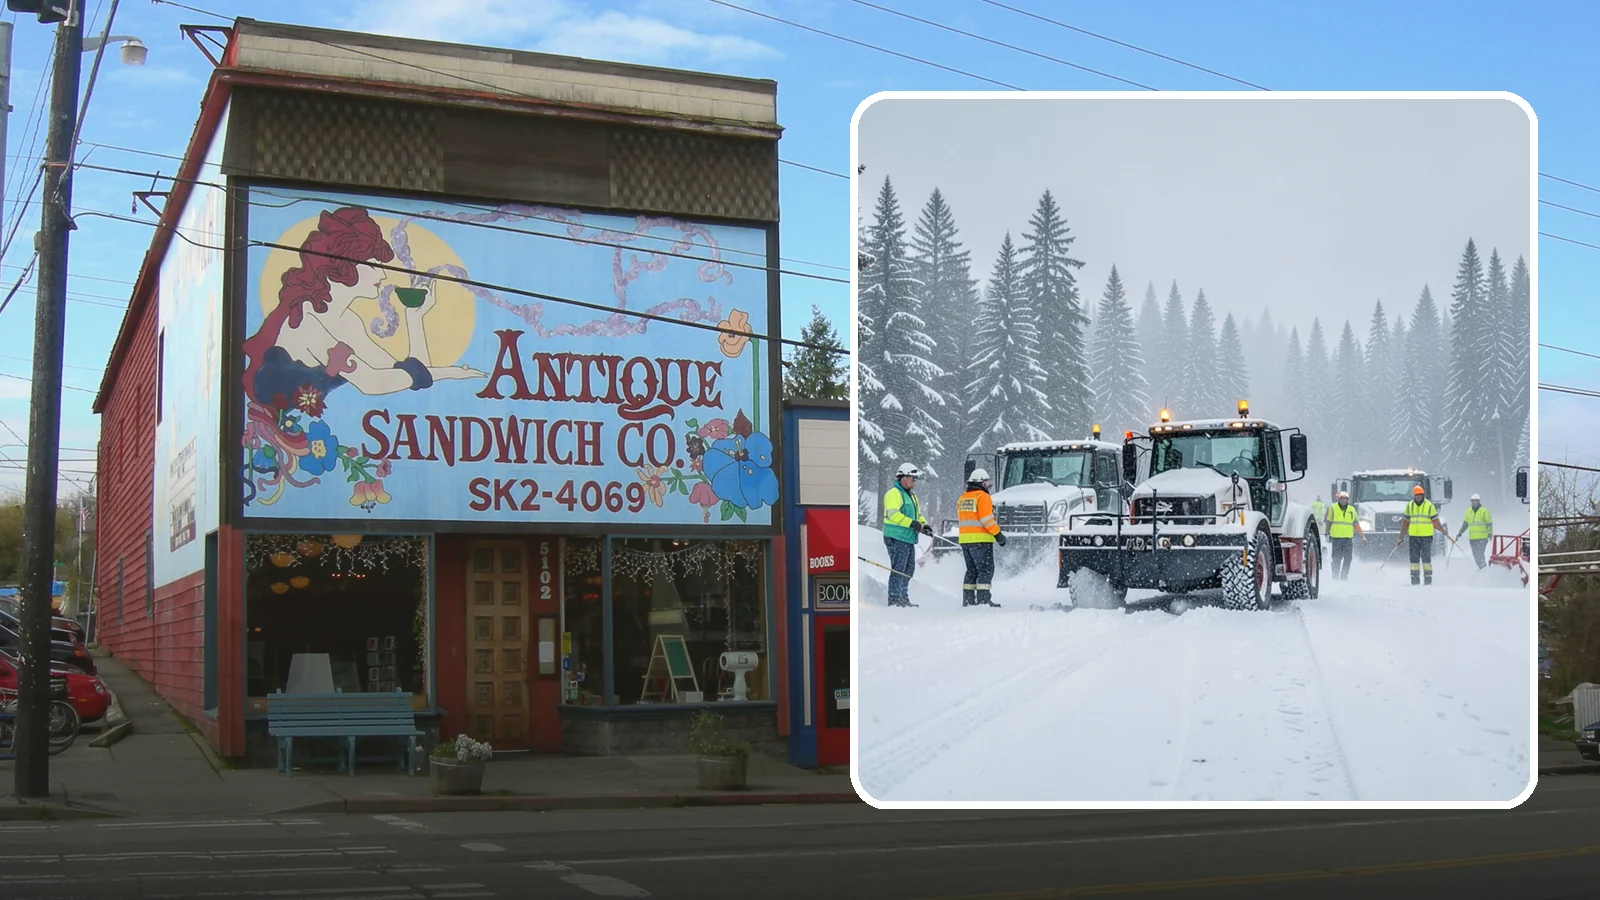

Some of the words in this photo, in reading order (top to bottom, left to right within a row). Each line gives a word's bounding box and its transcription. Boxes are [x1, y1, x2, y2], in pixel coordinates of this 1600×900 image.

[475, 329, 723, 421] ANTIQUE
[361, 408, 604, 467] SANDWICH
[618, 421, 685, 468] CO.
[468, 477, 645, 513] SK2-4069
[540, 542, 551, 599] 5102
[809, 555, 835, 569] BOOKS
